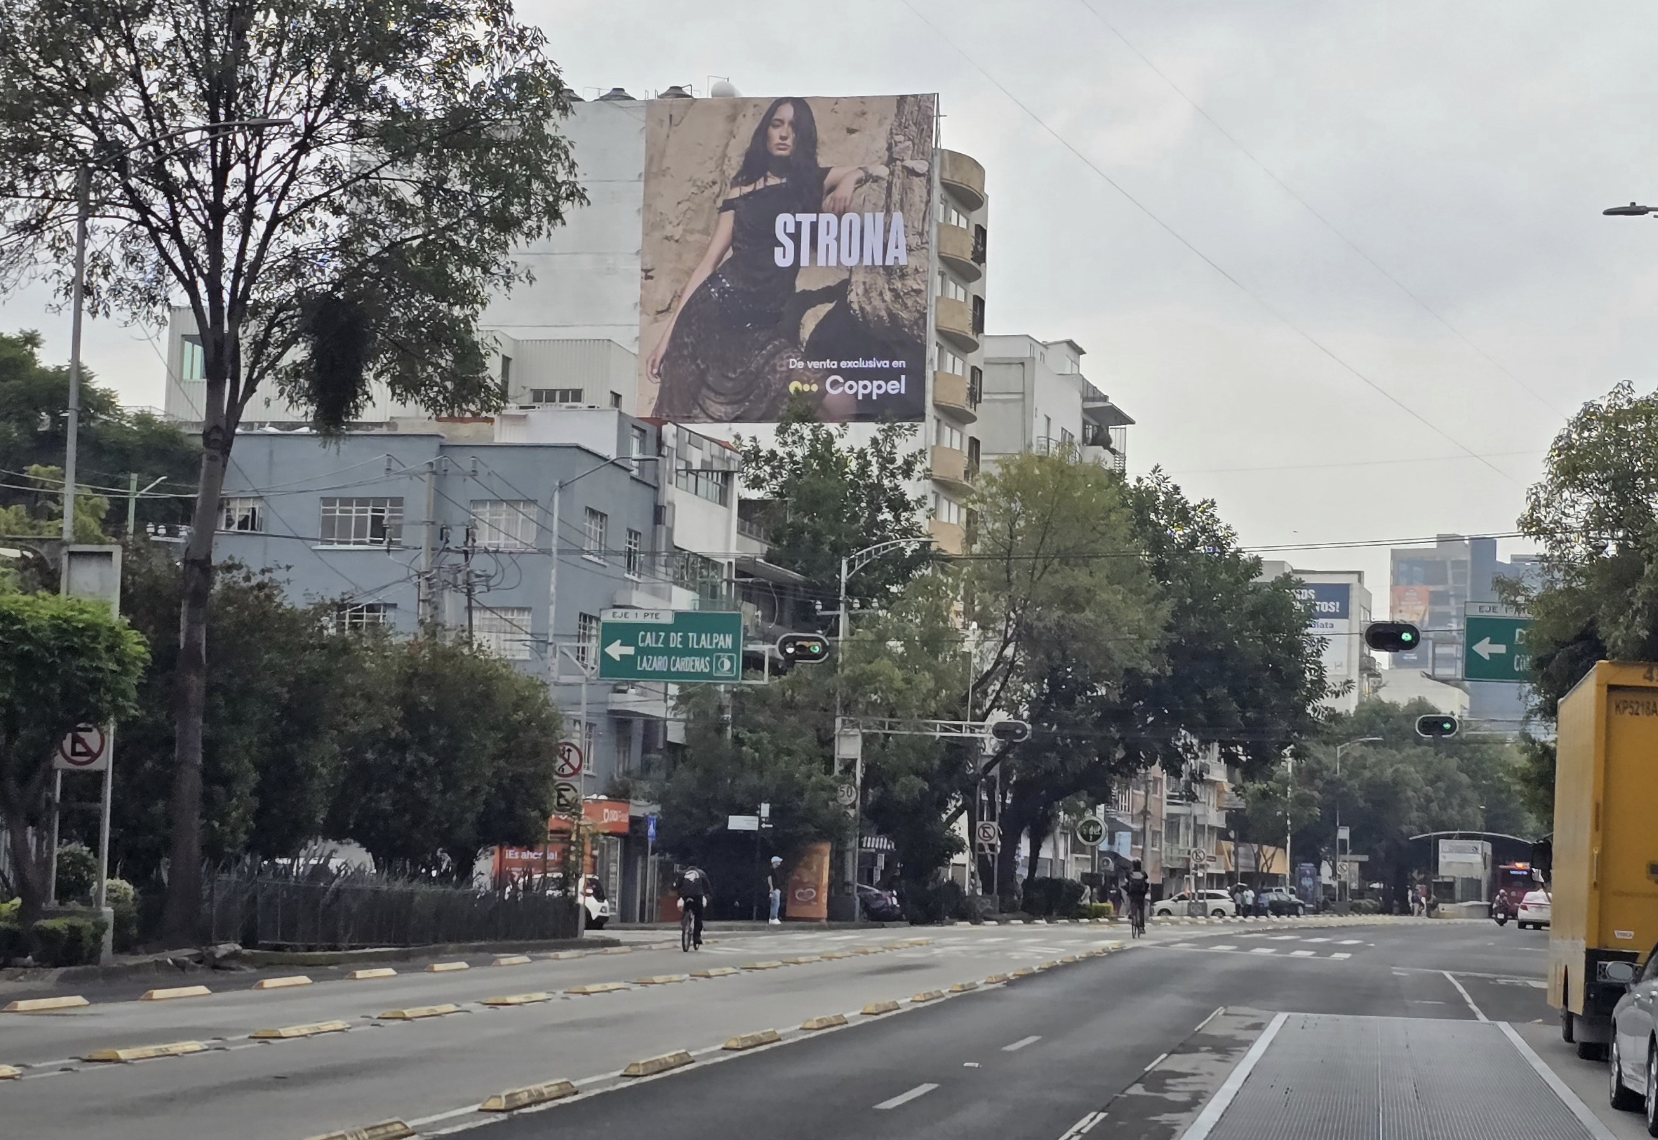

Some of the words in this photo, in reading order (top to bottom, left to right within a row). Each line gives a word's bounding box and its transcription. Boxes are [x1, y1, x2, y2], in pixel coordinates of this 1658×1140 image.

[774, 211, 908, 268] STRONA
[789, 358, 804, 368] De
[807, 359, 838, 369] venta
[840, 357, 890, 369] exclusiva
[892, 360, 906, 368] en
[825, 374, 906, 400] Coppel
[612, 611, 630, 619] EJE
[643, 612, 661, 620] PTE
[1478, 605, 1499, 614] EJE
[638, 631, 666, 648] CALZ
[669, 632, 684, 649] DE
[688, 633, 732, 649] TLALPAN
[637, 656, 668, 671] LAZARO
[670, 656, 710, 672] CARDENAS
[839, 785, 854, 798] 50
